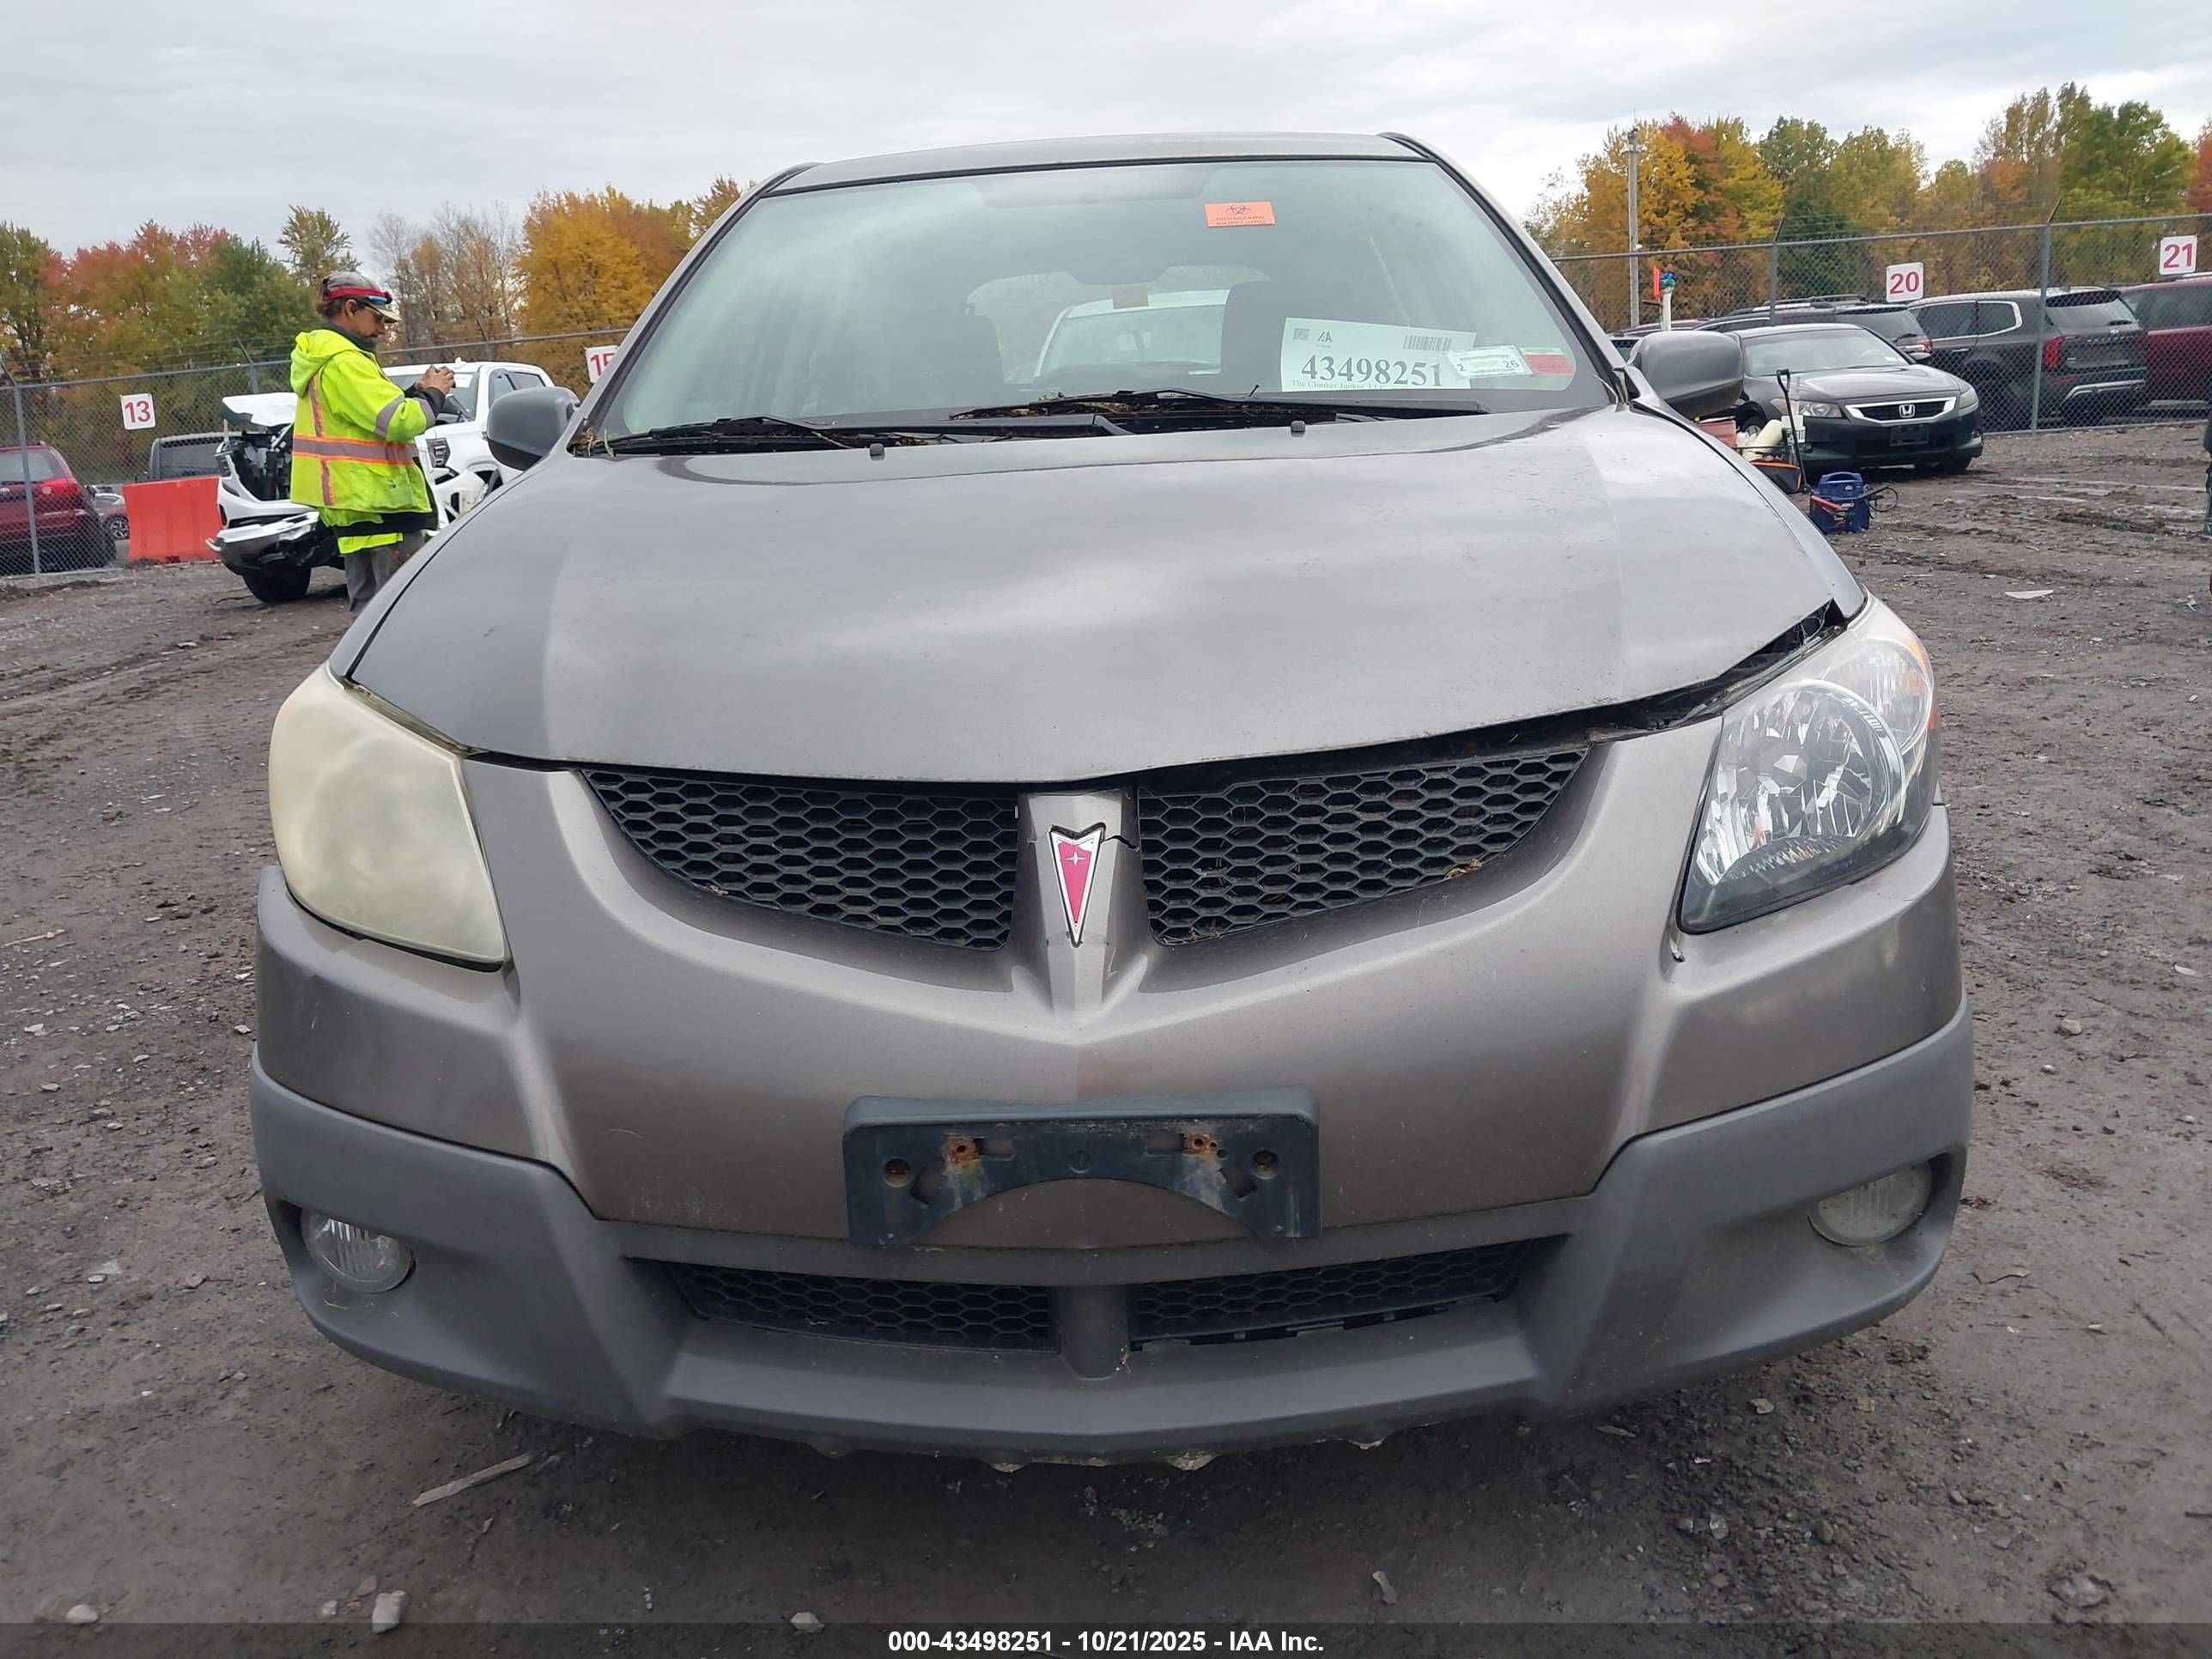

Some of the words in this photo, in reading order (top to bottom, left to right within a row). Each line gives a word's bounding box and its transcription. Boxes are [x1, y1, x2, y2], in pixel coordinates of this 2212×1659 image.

[2163, 243, 2192, 268] 21
[1890, 271, 1919, 294] 20
[1301, 355, 1443, 386] 43498251
[1503, 360, 1519, 368] 26
[125, 400, 150, 422] 13
